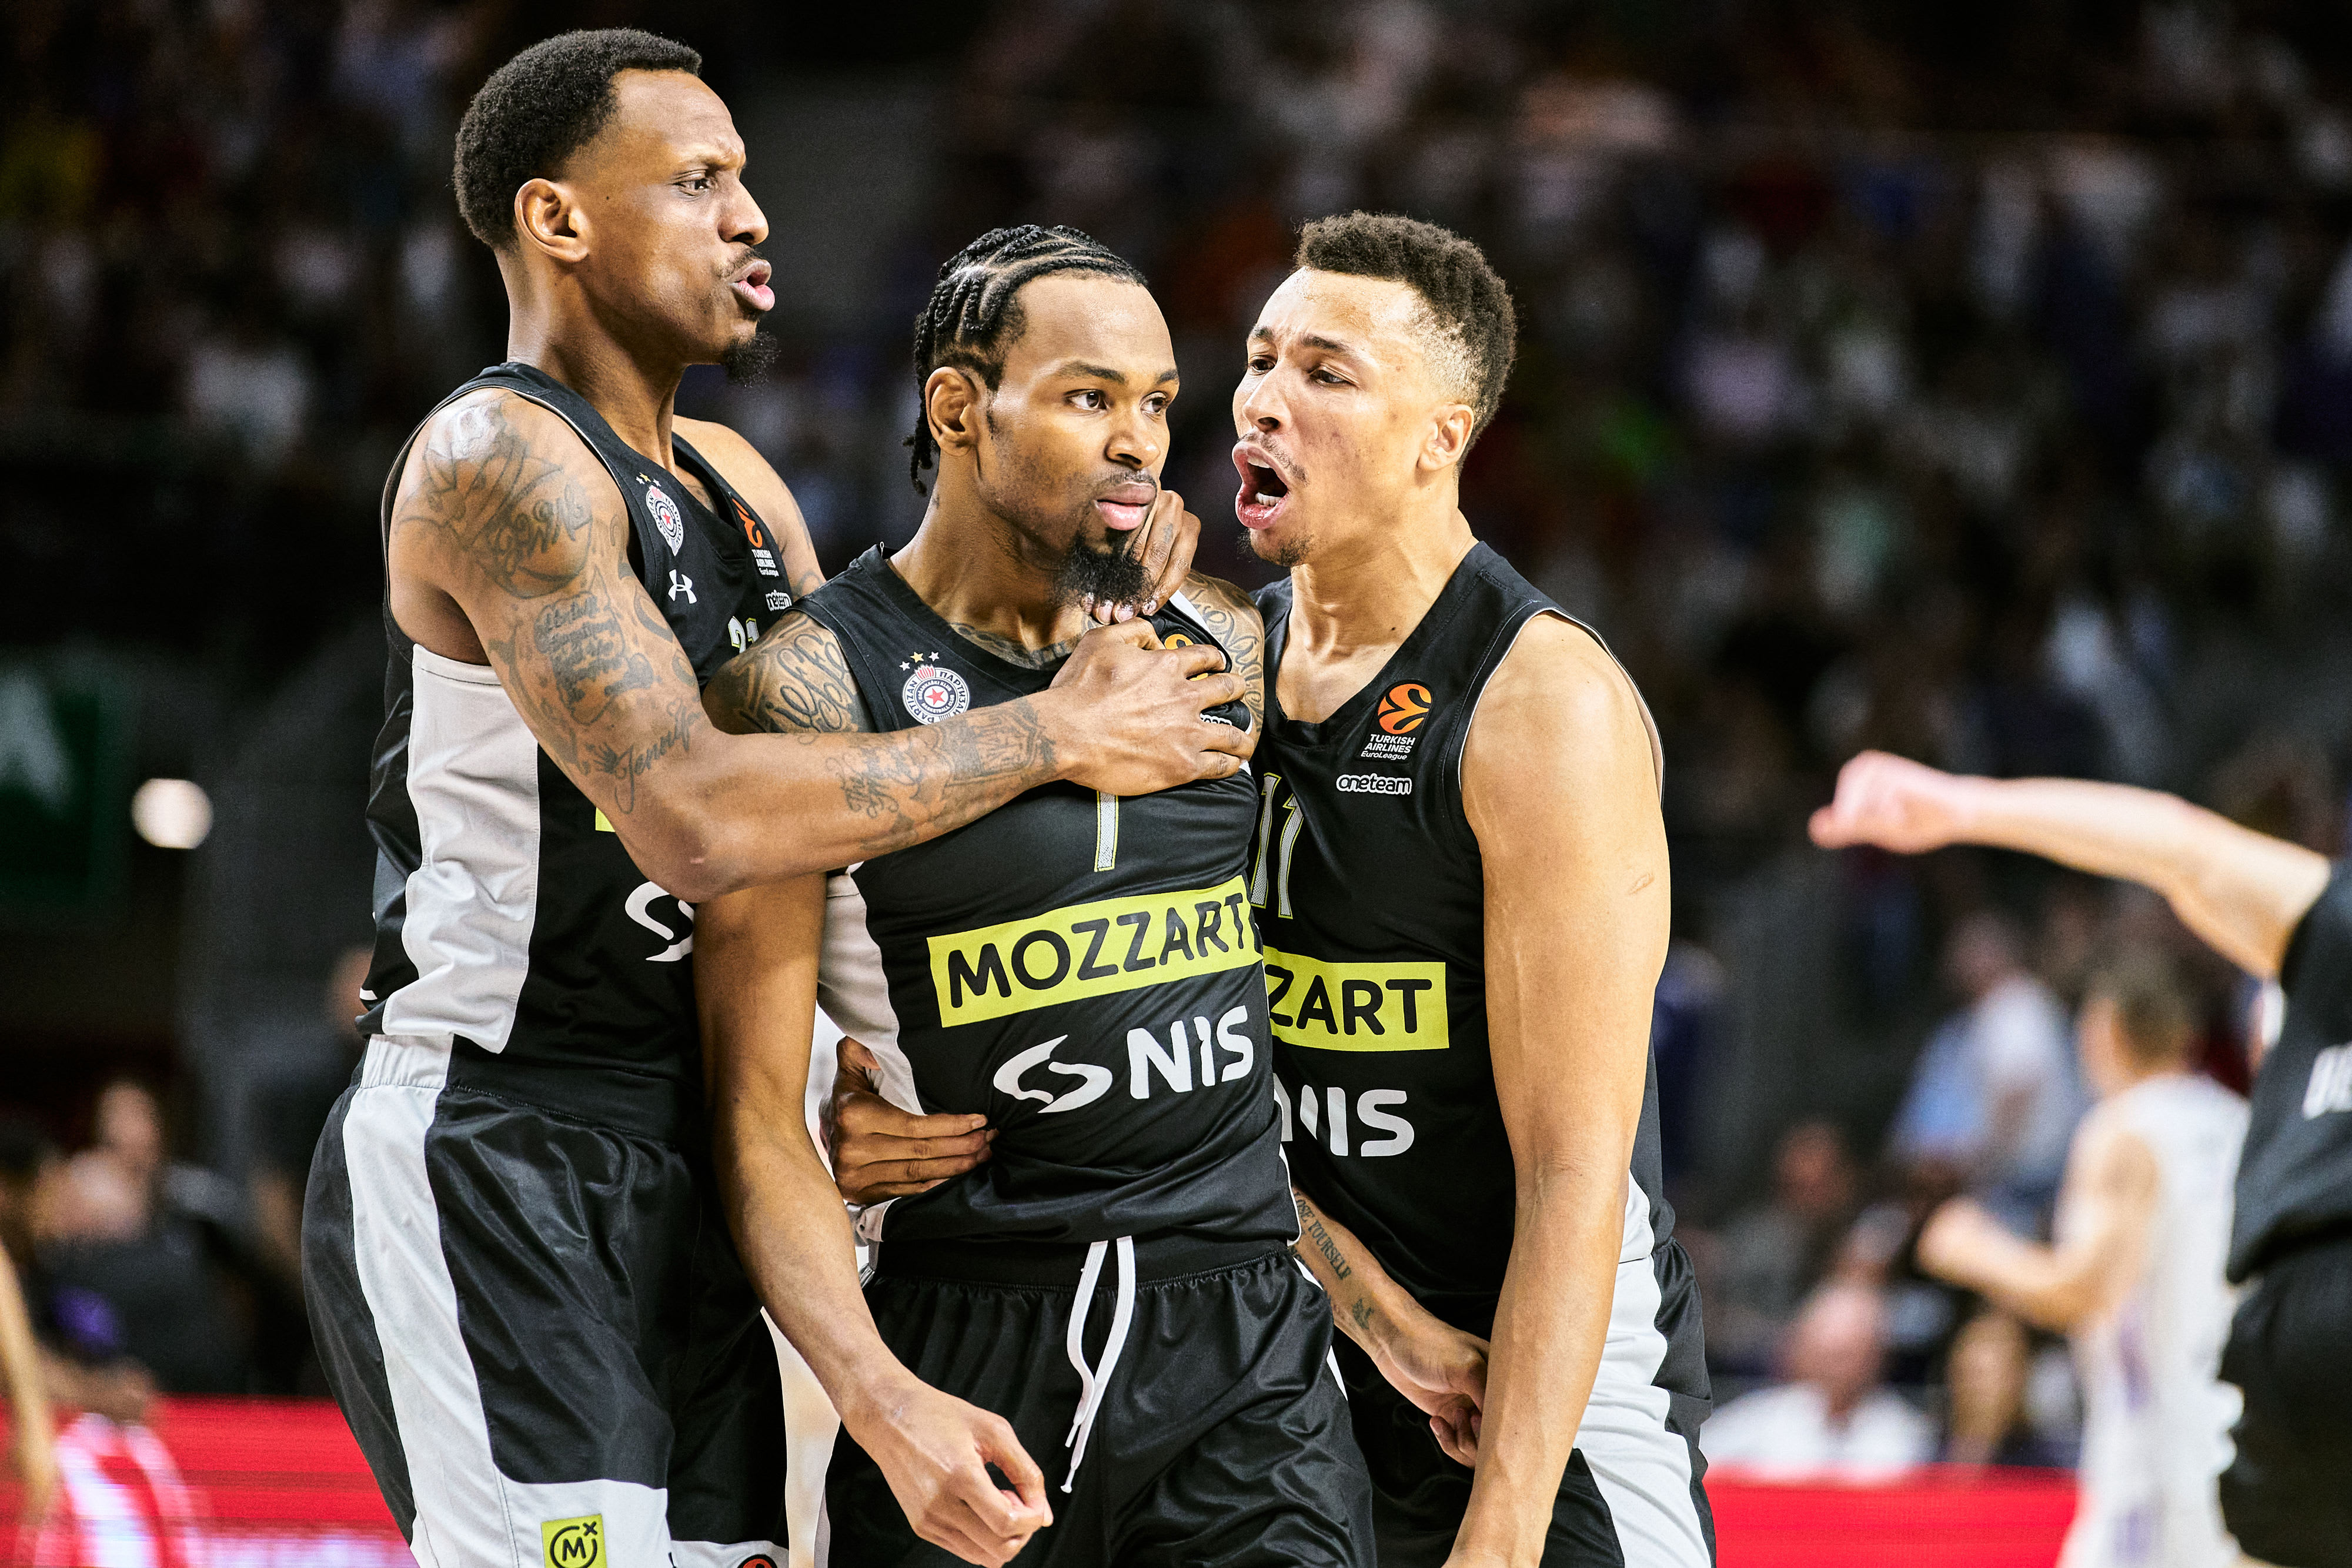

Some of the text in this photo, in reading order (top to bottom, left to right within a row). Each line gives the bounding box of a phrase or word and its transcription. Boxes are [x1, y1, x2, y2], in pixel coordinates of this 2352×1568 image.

[906, 680, 935, 724] PARTIZAN
[939, 671, 966, 716] ПАРТИЗАН
[1360, 750, 1408, 761] EuroLeague
[1364, 743, 1412, 754] AIRLINES
[1370, 734, 1416, 745] TURKISH
[1337, 773, 1412, 795] oneteam
[947, 892, 1244, 1008] MOZZART
[1127, 1005, 1254, 1099] NIS
[1308, 1220, 1351, 1281] YOURSELF
